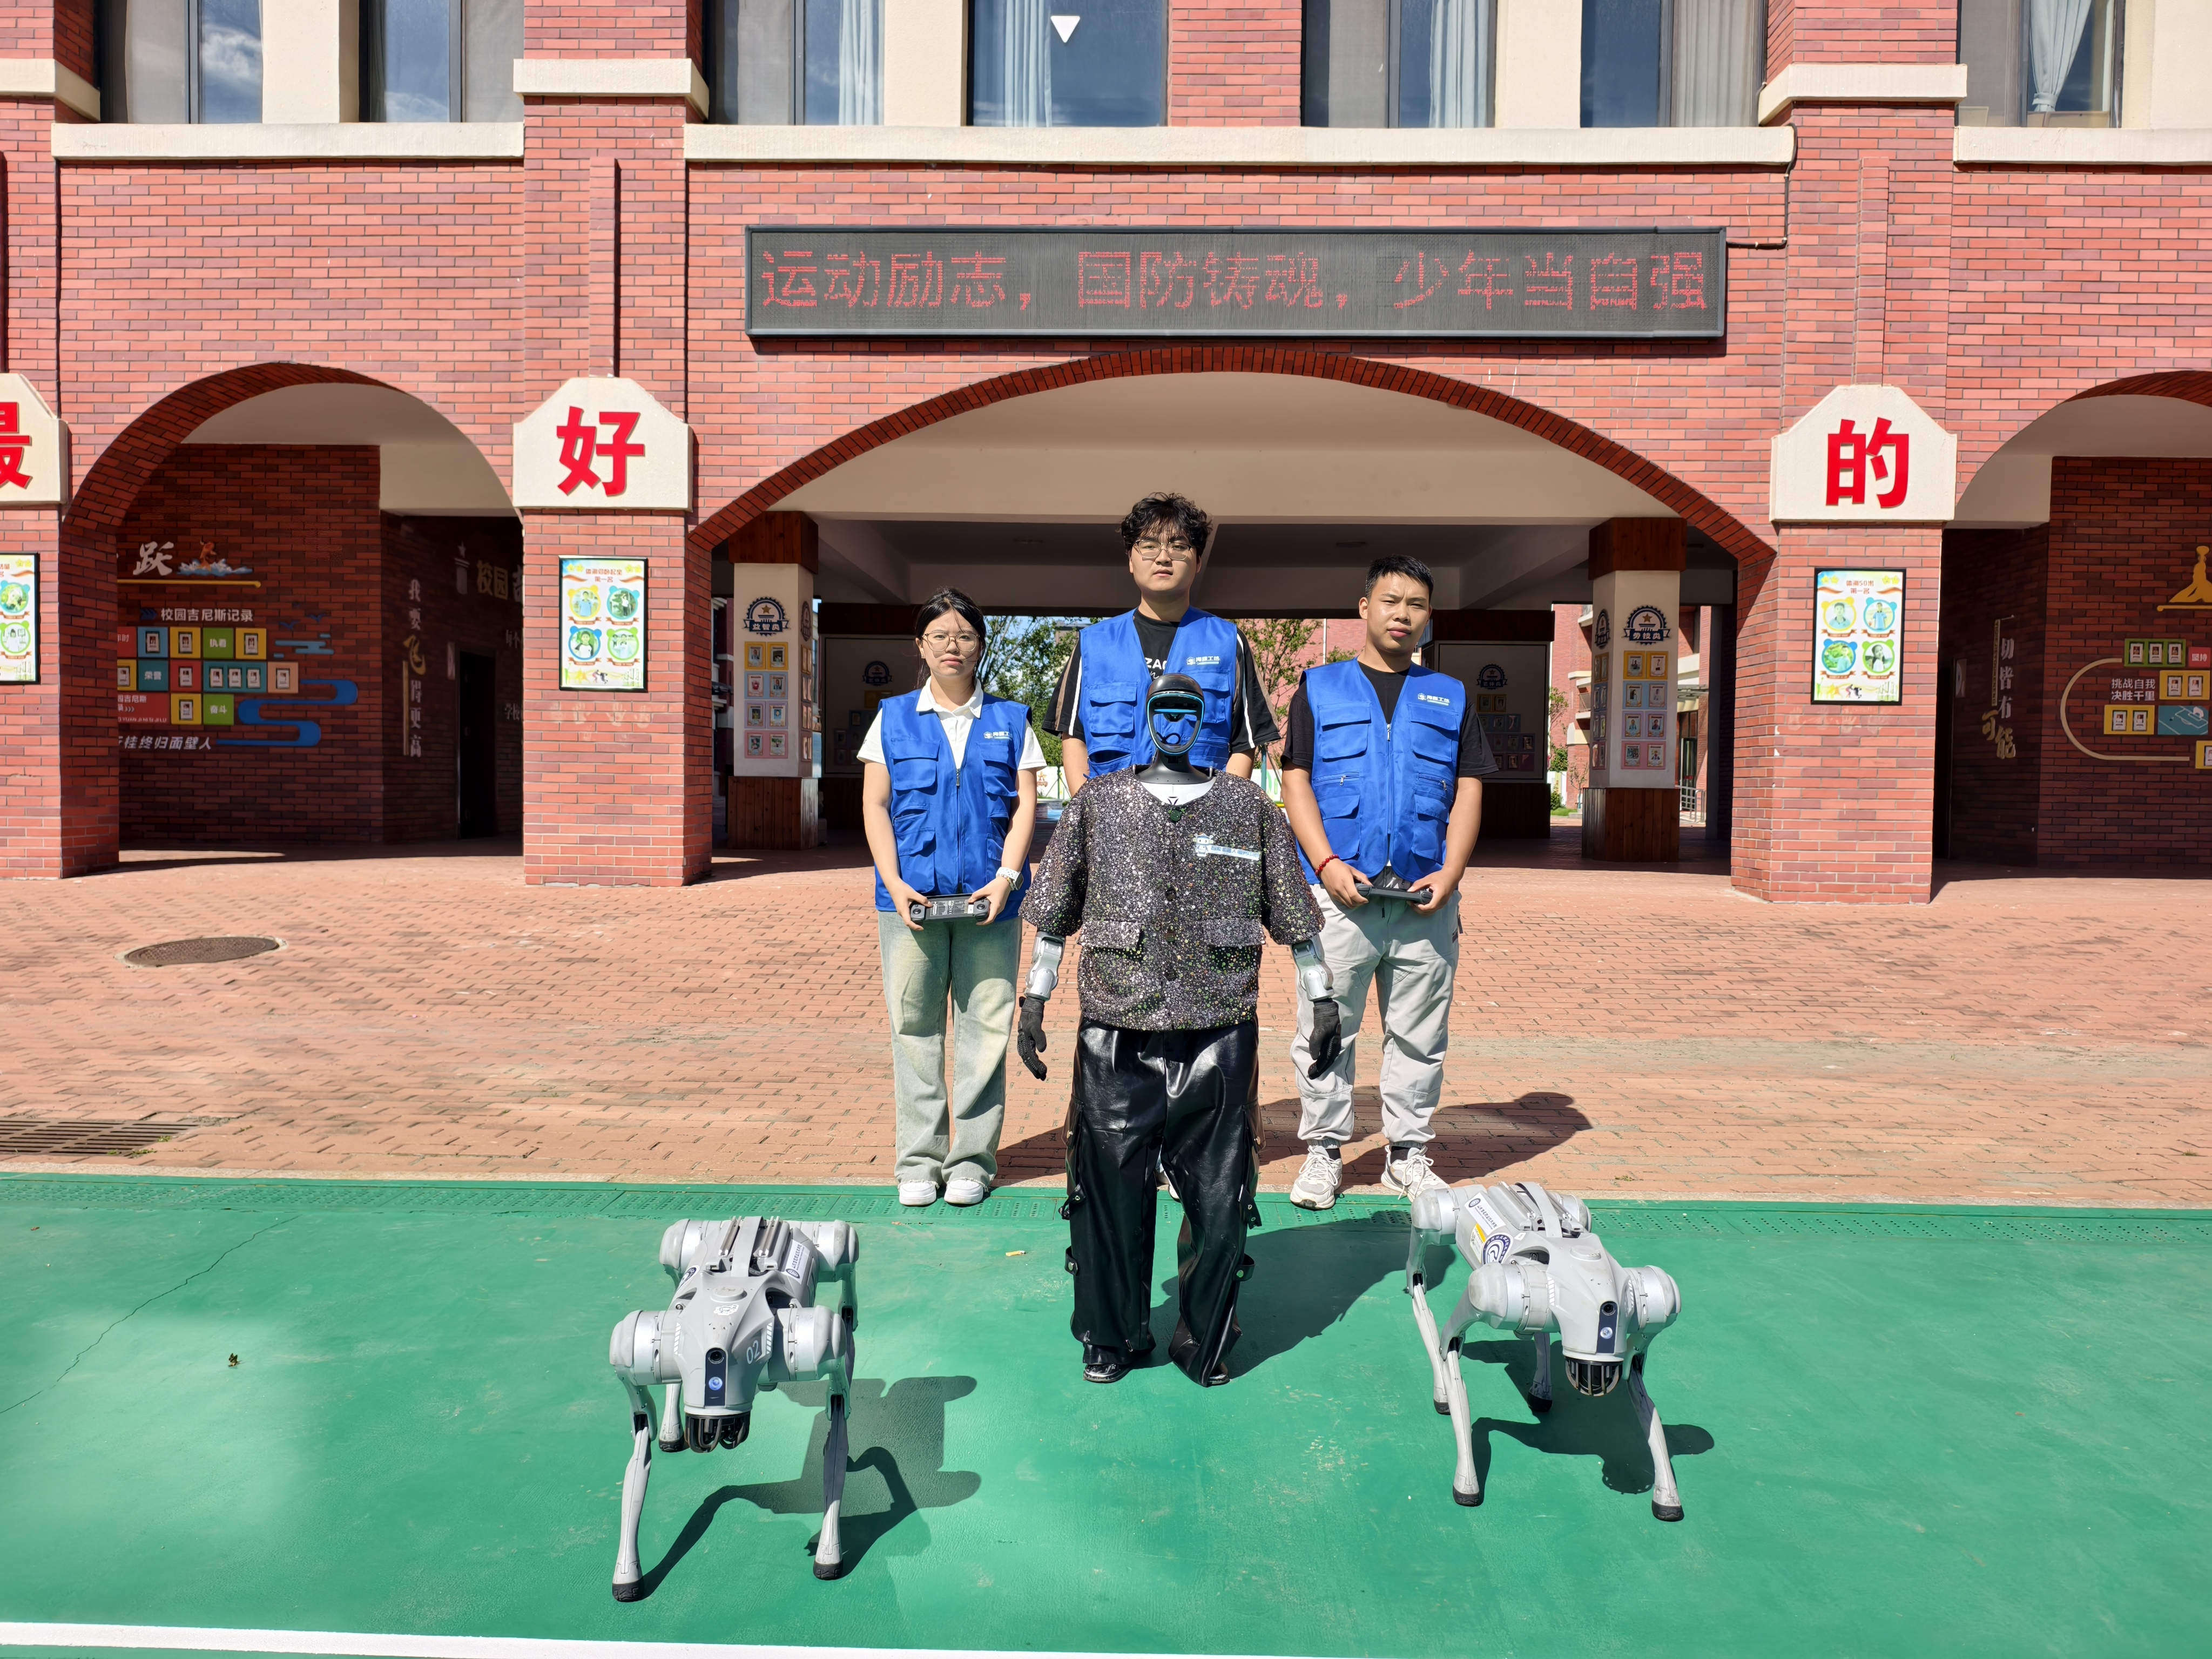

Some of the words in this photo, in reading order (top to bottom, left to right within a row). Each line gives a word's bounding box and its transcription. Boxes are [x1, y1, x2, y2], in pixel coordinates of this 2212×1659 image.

[557, 406, 646, 497] 好
[1825, 417, 1910, 509] 的
[132, 541, 174, 576] 跃
[161, 608, 253, 622] 校园吉尼斯记录
[403, 578, 426, 757] 我要飞得更高
[2111, 678, 2156, 690] 挑战自我
[2111, 690, 2155, 701] 决胜千里
[746, 1340, 760, 1364] 02
